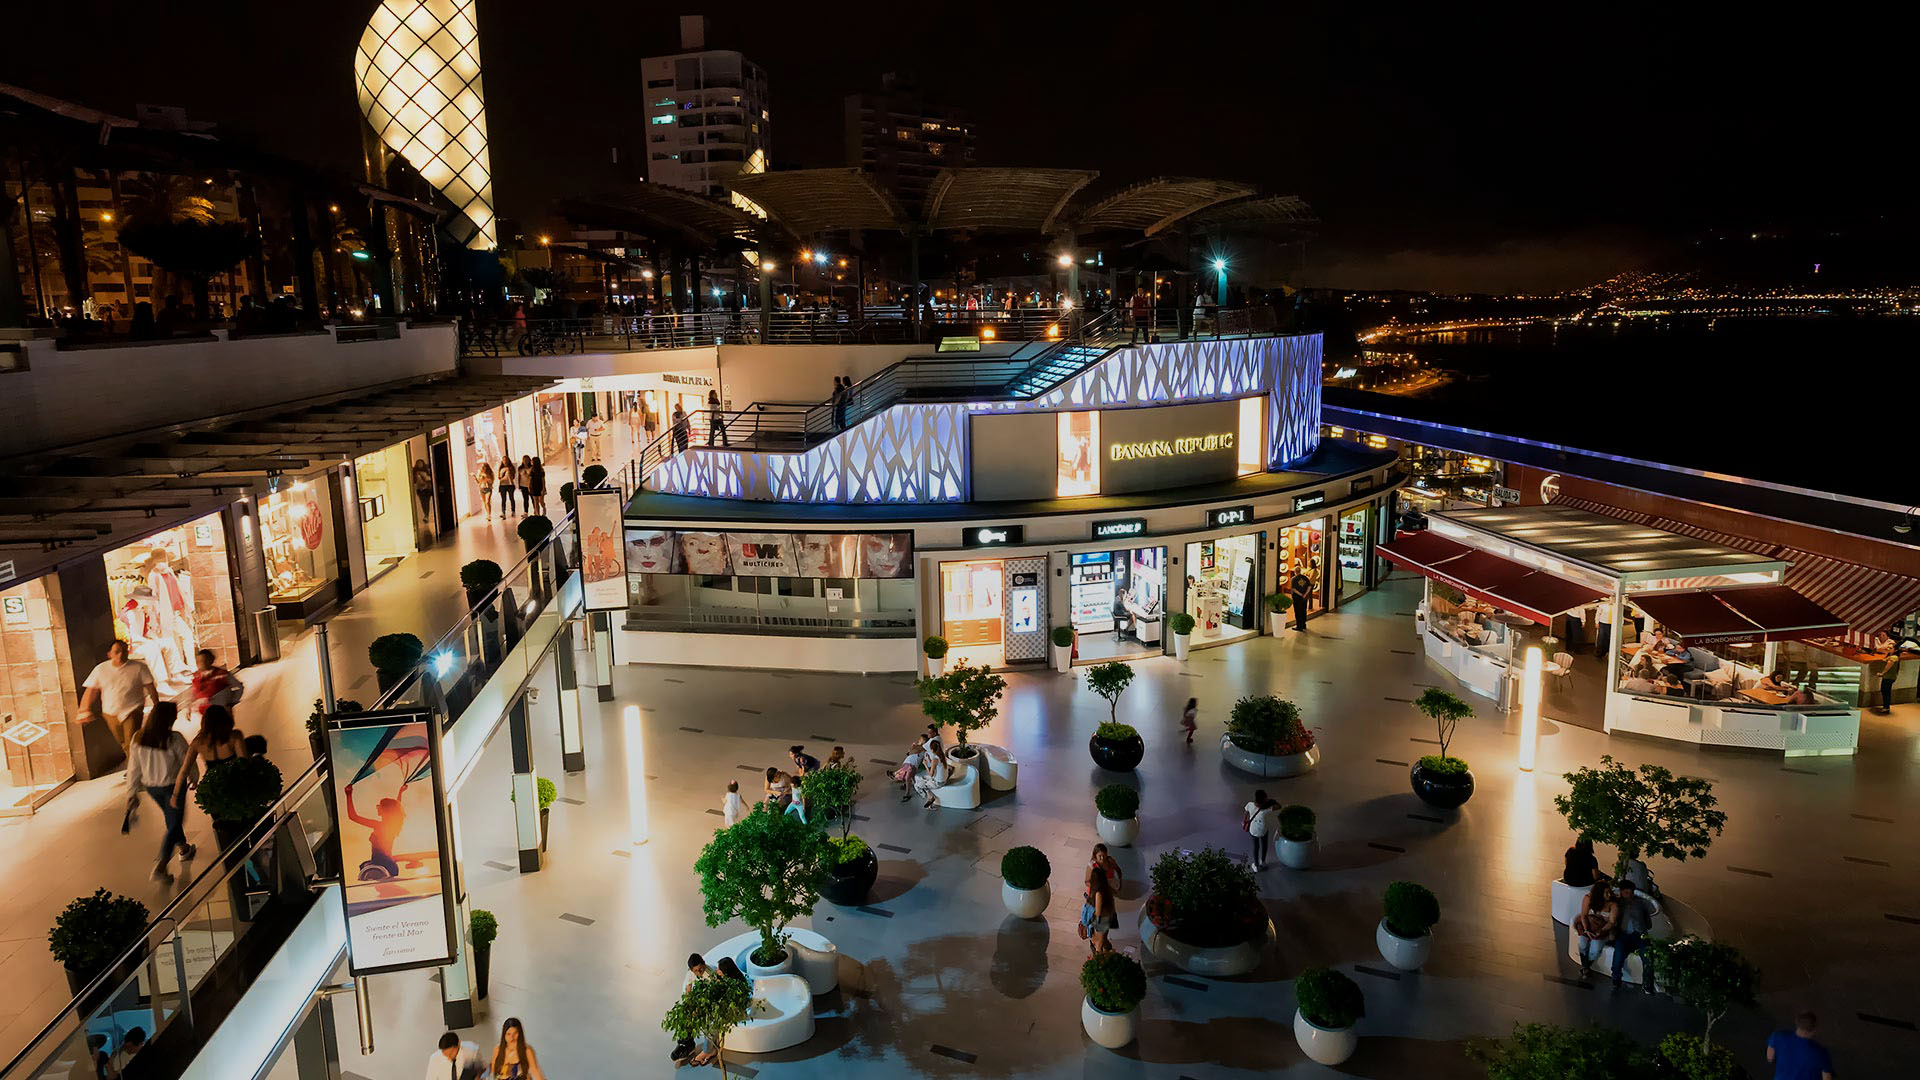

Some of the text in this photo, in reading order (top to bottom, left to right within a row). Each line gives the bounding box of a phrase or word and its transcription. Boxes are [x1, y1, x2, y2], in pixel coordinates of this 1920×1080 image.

[1111, 433, 1233, 461] BANANA REPUBLIC
[743, 543, 782, 560] UVK
[743, 560, 784, 568] MULTICINES
[391, 921, 399, 929] el
[396, 930, 405, 938] al
